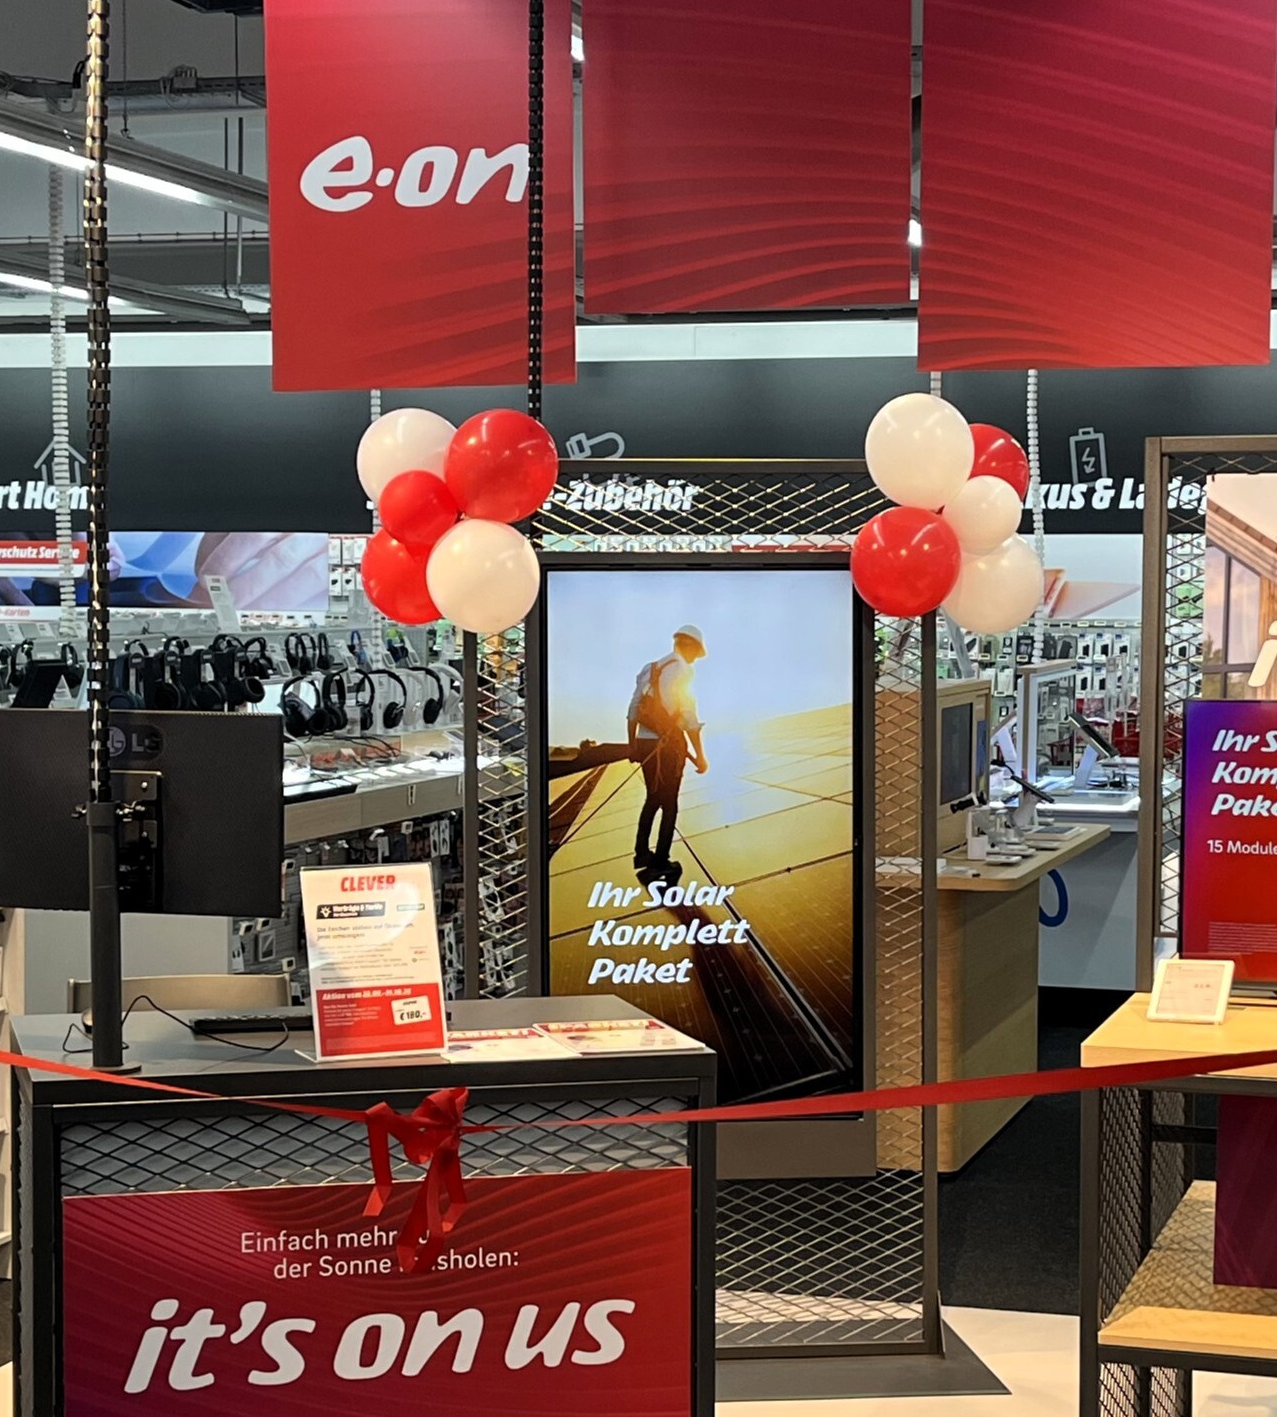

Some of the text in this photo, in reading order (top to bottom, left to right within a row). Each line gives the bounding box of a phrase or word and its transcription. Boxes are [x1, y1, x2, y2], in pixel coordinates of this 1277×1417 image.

[24, 481, 90, 509] Hom
[543, 479, 700, 510] -Zubehör
[1091, 477, 1116, 510] &
[39, 546, 80, 559] Sere
[1212, 729, 1260, 752] Ihr
[1207, 840, 1223, 853] 15
[340, 875, 396, 892] CLEVER
[588, 880, 736, 909] Ihr Solar
[588, 918, 751, 951] Komplett
[588, 957, 693, 985] Paket
[241, 1229, 328, 1253] Einfach
[337, 1226, 397, 1248] mehr
[274, 1257, 312, 1279] der
[319, 1256, 391, 1277] Sonne
[333, 1306, 485, 1381] on
[504, 1299, 635, 1370] us
